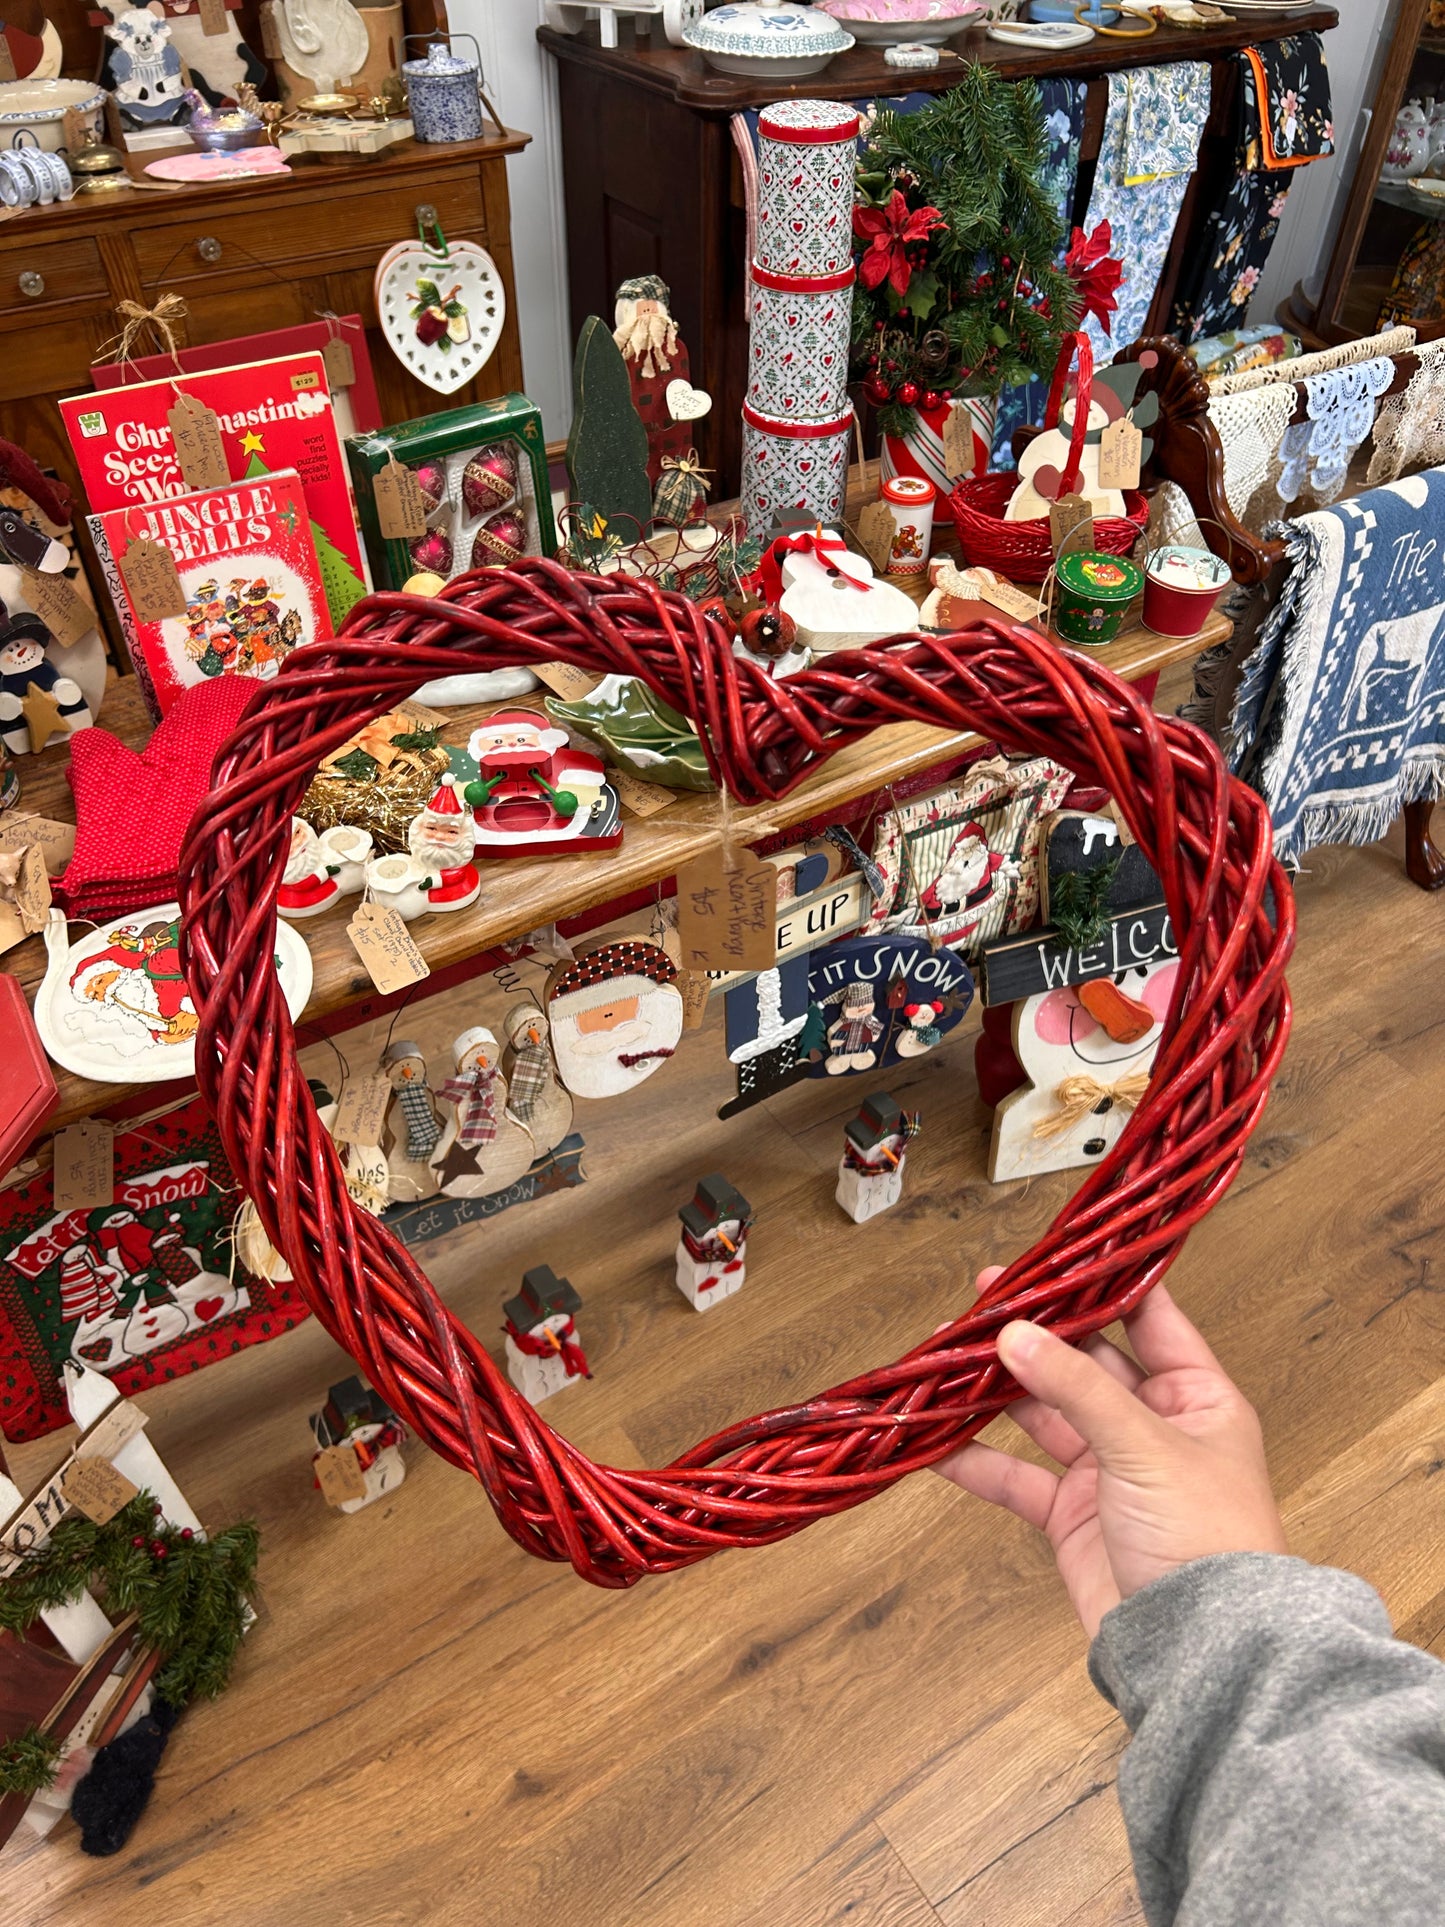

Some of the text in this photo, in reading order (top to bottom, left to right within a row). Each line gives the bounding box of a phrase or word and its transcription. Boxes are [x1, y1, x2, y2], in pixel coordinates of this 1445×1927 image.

[115, 392, 328, 451] Chrmastim
[303, 434, 324, 445] word
[310, 444, 326, 453] find
[297, 455, 328, 467] puzzles
[299, 464, 329, 477] pecially
[312, 472, 331, 483] kids!
[139, 486, 277, 540] JINGLE
[156, 515, 272, 563] BELLS
[1387, 530, 1436, 588] The
[690, 887, 719, 915] $5
[746, 869, 772, 933] Vintage
[807, 893, 849, 934] UP
[354, 927, 375, 946] $15
[388, 909, 404, 936] Vintage
[691, 950, 709, 962] K
[823, 960, 847, 985] IT
[854, 946, 965, 993] SNOW
[62, 1217, 87, 1240] it
[123, 1174, 206, 1212] Snow
[397, 1211, 443, 1245] Let
[453, 1202, 474, 1226] it
